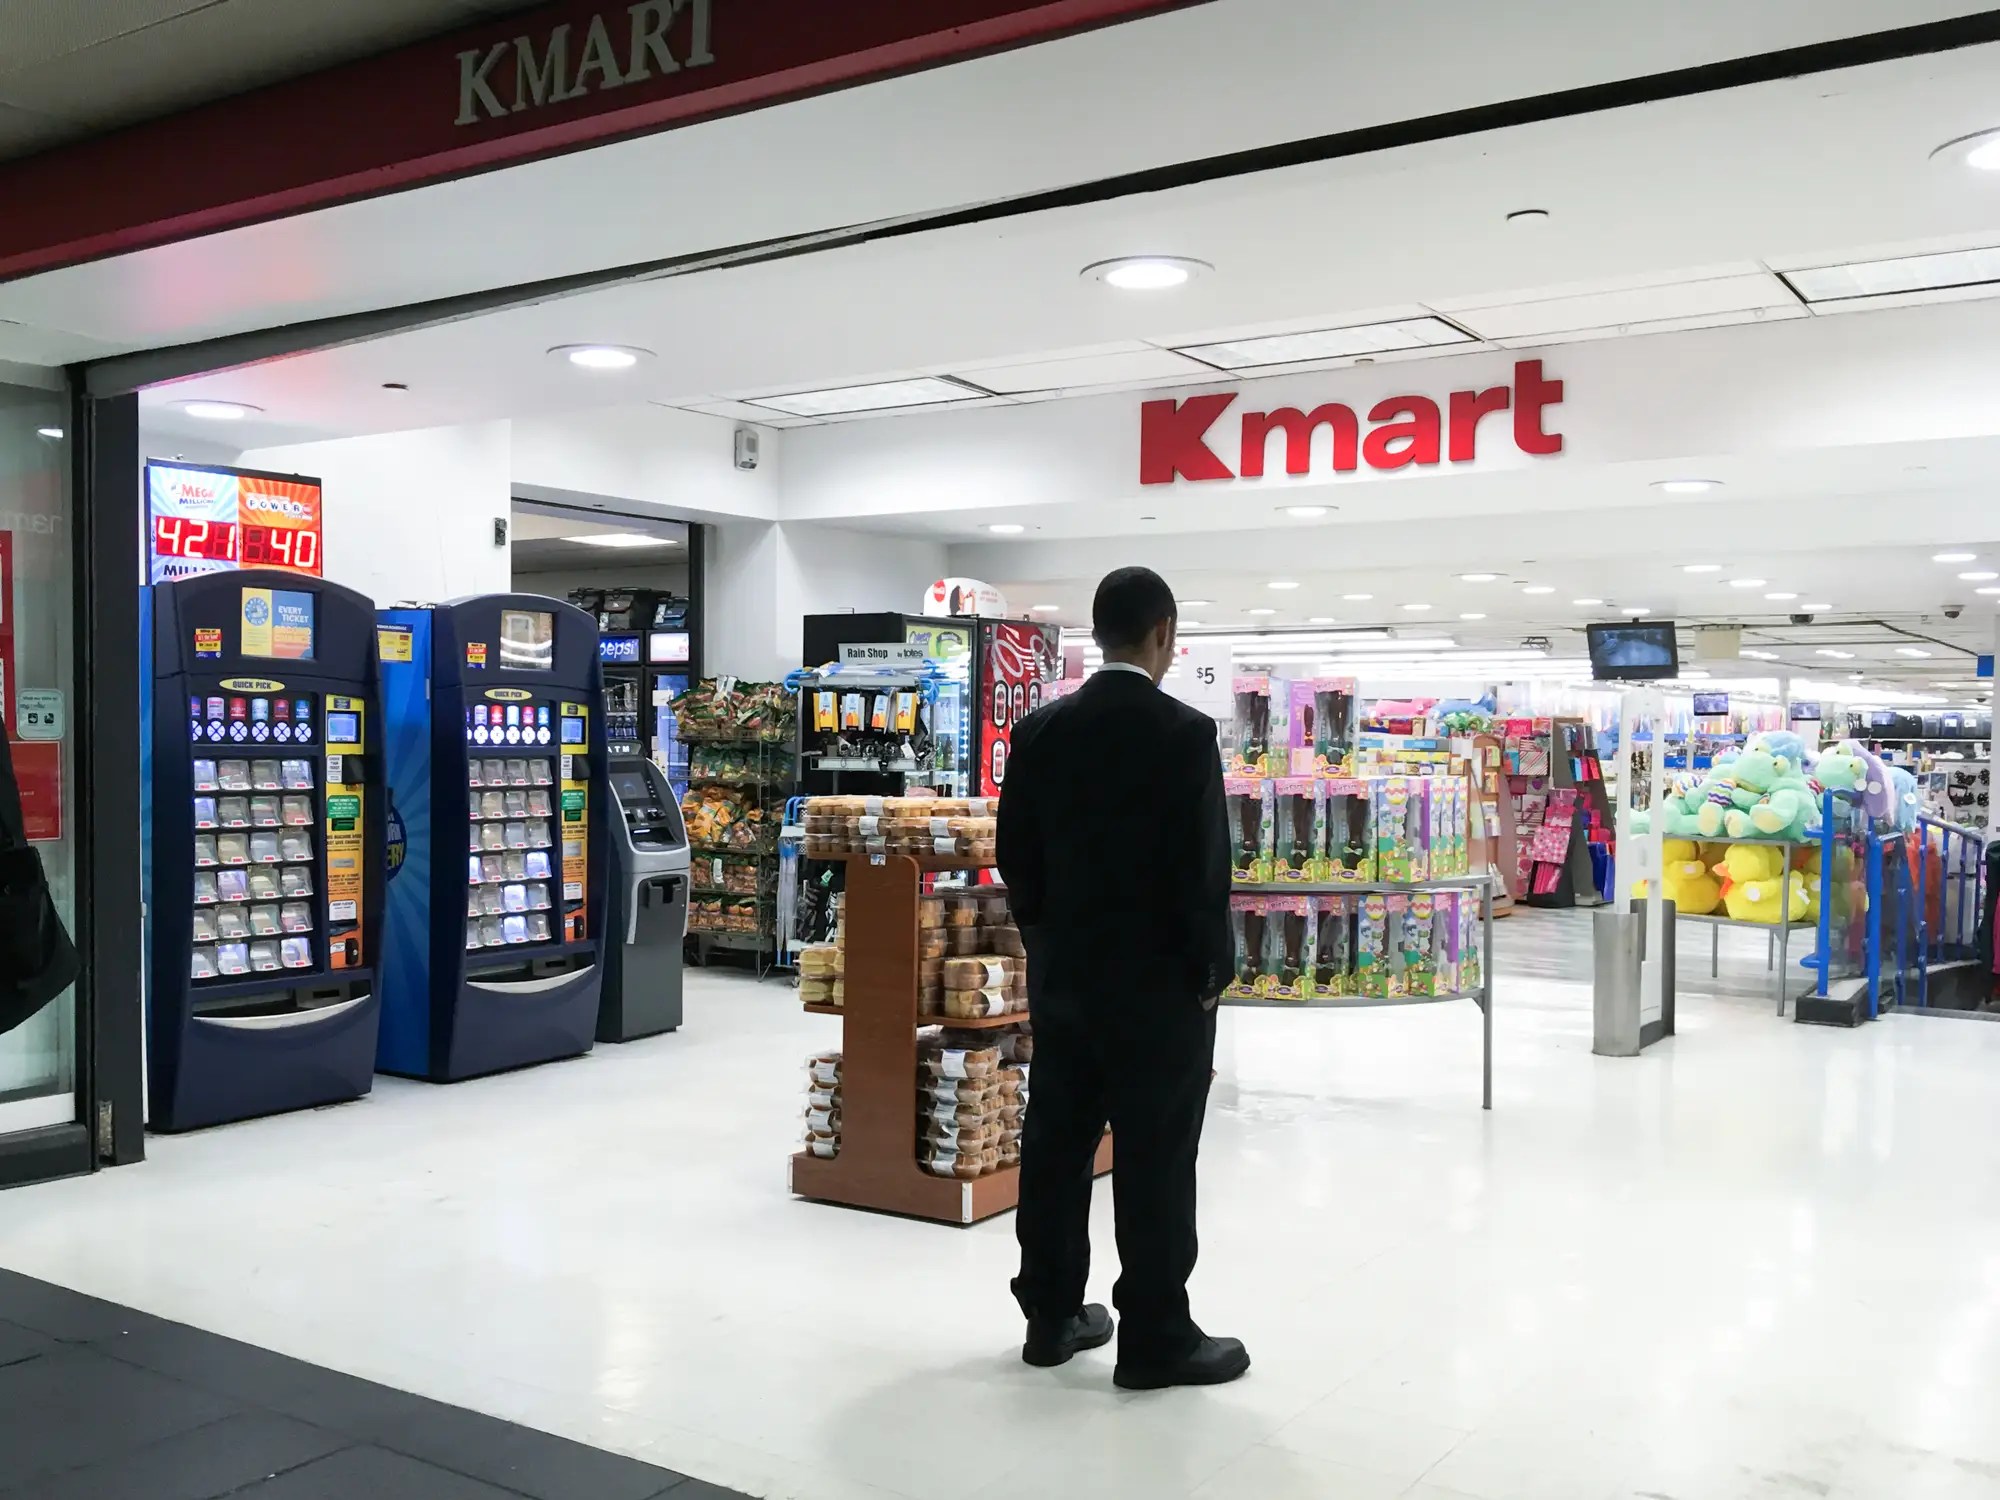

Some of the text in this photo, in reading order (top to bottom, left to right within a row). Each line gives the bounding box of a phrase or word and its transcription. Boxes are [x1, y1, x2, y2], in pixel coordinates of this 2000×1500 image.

[454, 0, 714, 125] KMART
[1141, 359, 1563, 484] Kmart
[271, 529, 317, 567] 40
[278, 605, 302, 614] EVERY
[282, 614, 309, 623] TICKET
[847, 648, 866, 659] Rain
[868, 648, 888, 660] Shop
[904, 648, 924, 658] totes
[1196, 667, 1215, 684] $5
[232, 680, 272, 689] QUICK PICK
